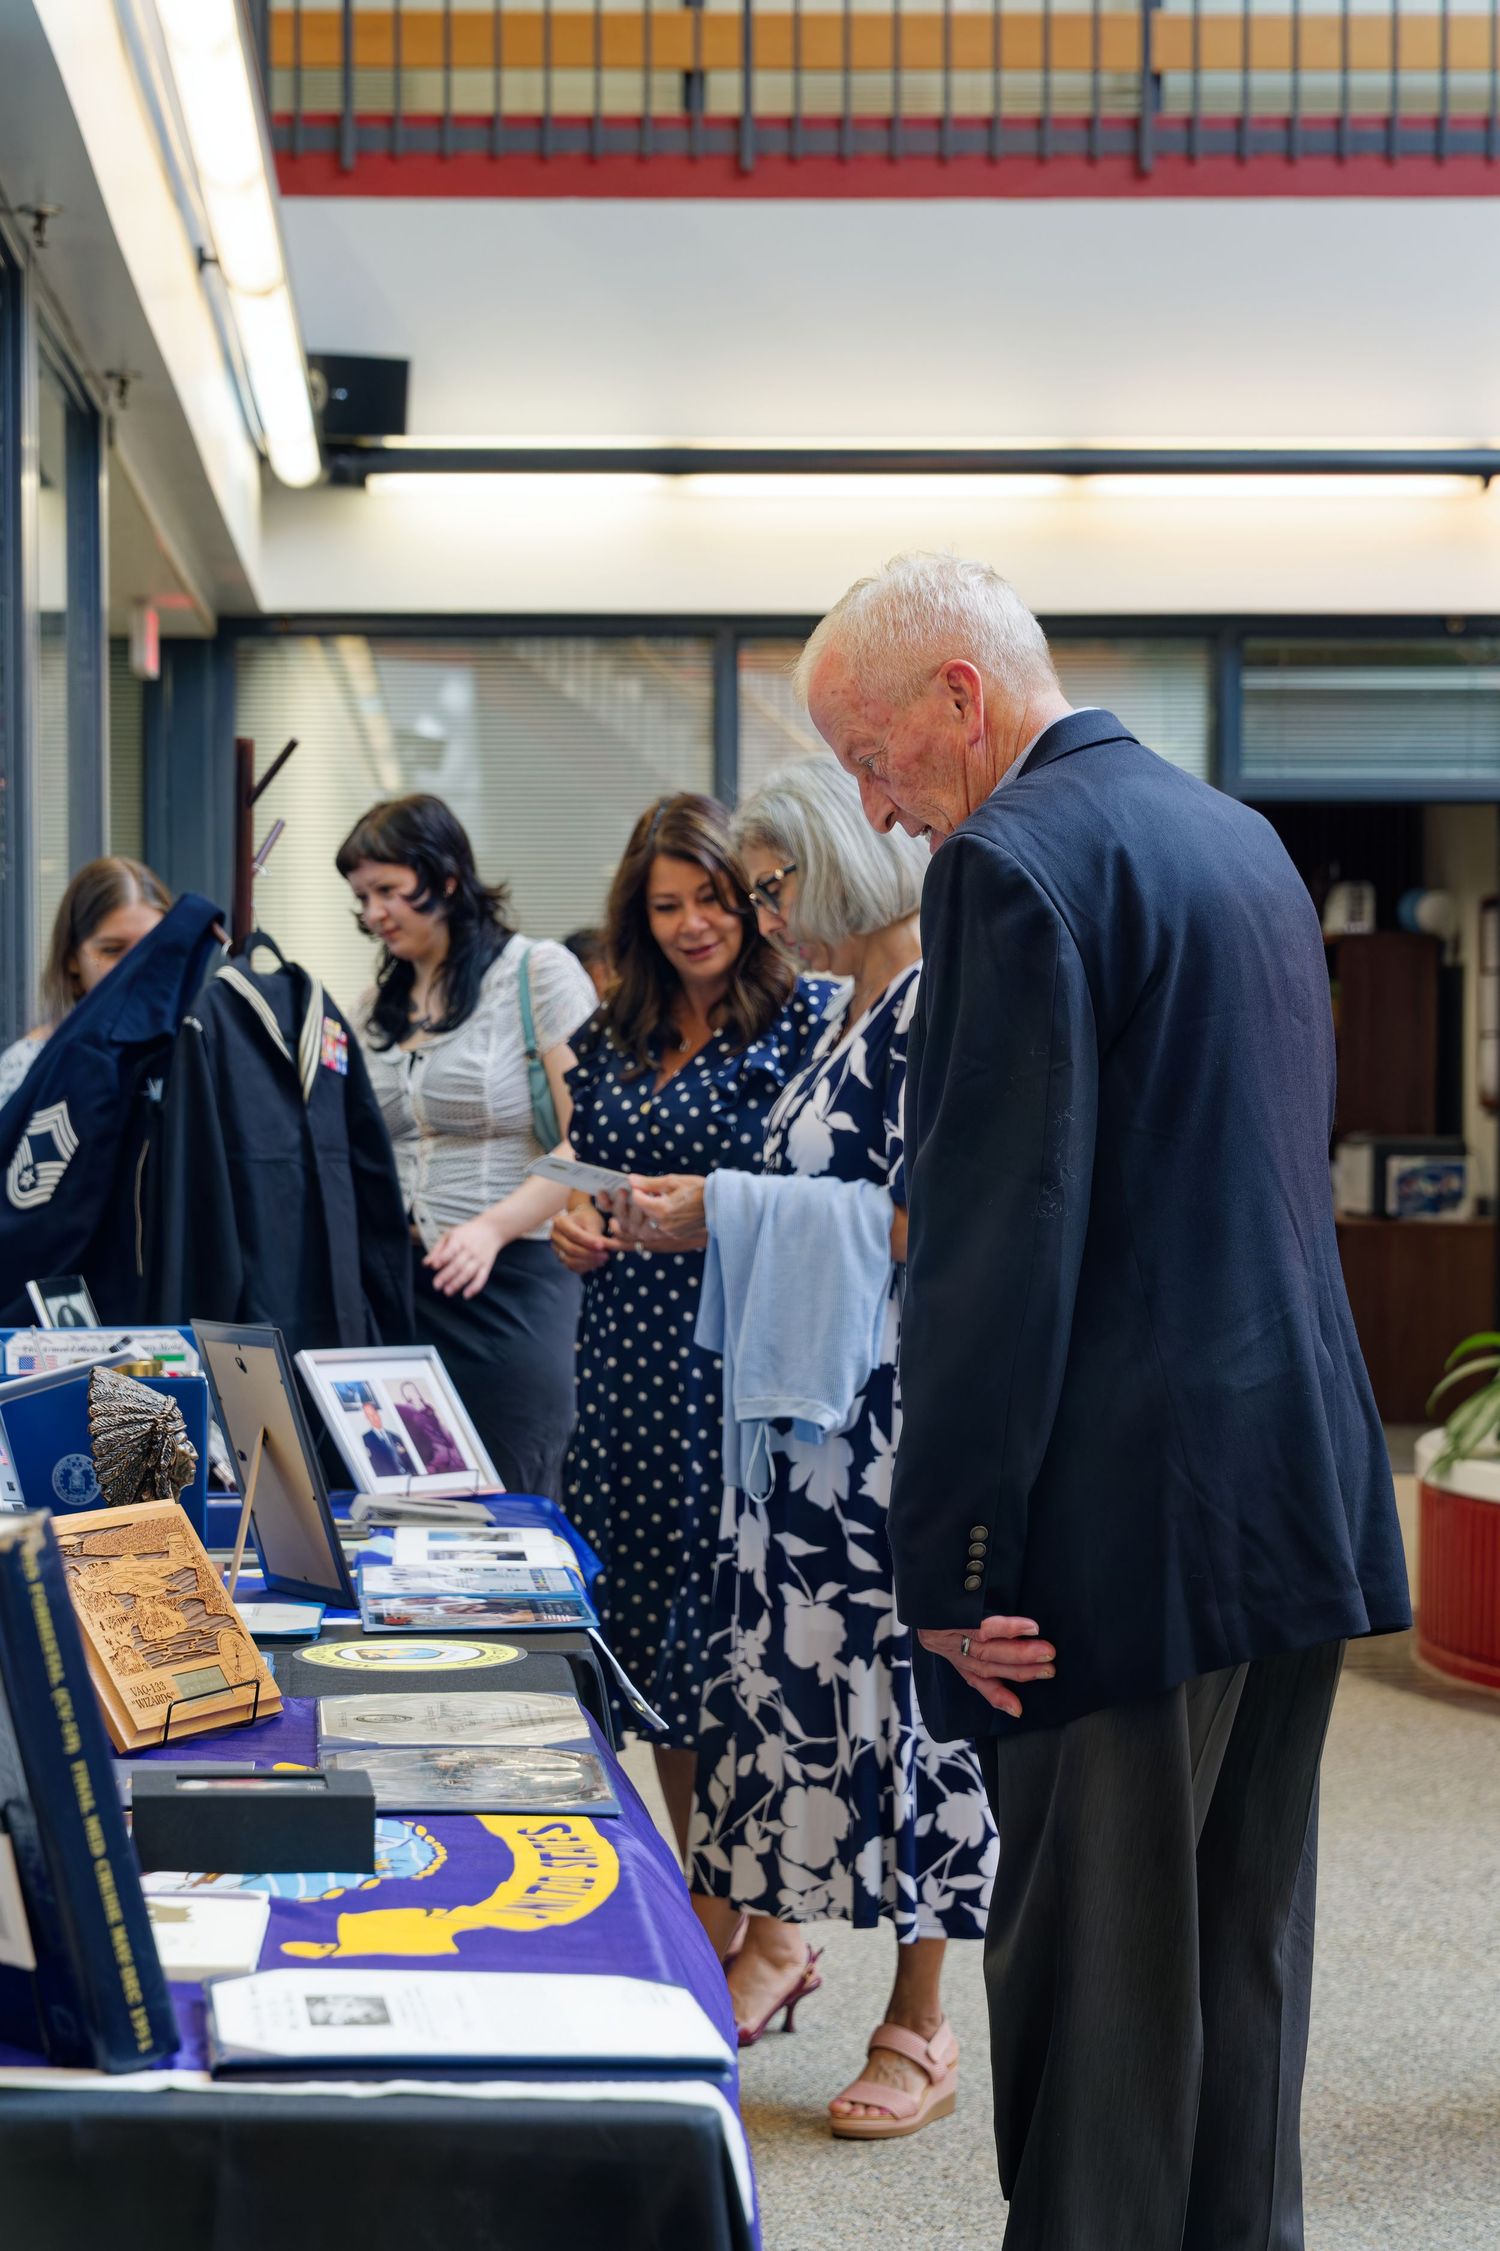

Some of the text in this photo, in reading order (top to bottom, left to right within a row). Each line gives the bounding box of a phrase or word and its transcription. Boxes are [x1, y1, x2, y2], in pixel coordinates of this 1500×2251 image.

[129, 1680, 167, 1698] VAQ-133
[131, 1691, 176, 1710] "WIZARDS"
[70, 1759, 96, 1816] FINAL
[94, 1857, 124, 1925] CRUISE
[517, 1822, 600, 1869] STATES
